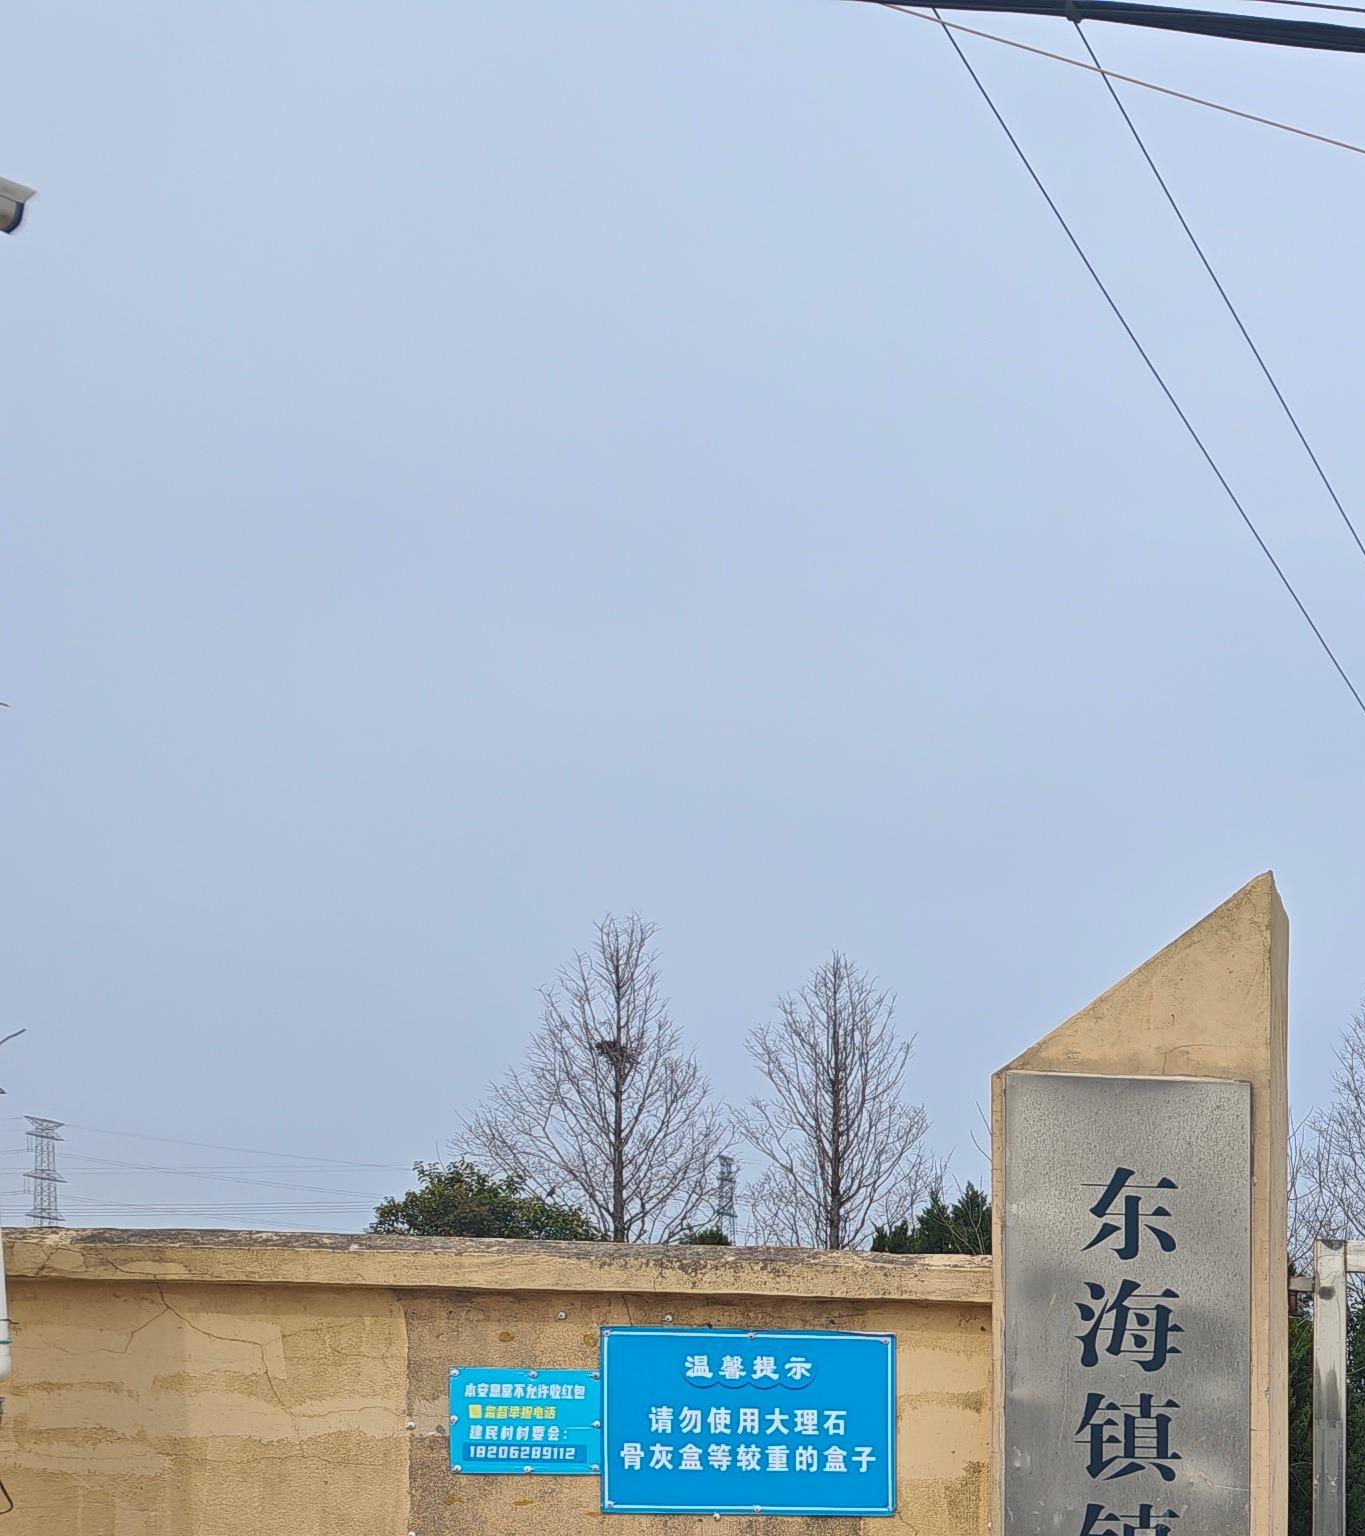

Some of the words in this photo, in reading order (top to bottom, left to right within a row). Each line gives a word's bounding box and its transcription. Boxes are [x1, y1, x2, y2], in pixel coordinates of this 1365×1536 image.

[684, 1354, 813, 1381] 温馨提示
[648, 1406, 847, 1436] 请勿使用大理石
[619, 1442, 877, 1474] 骨灰盒等较重的盒子
